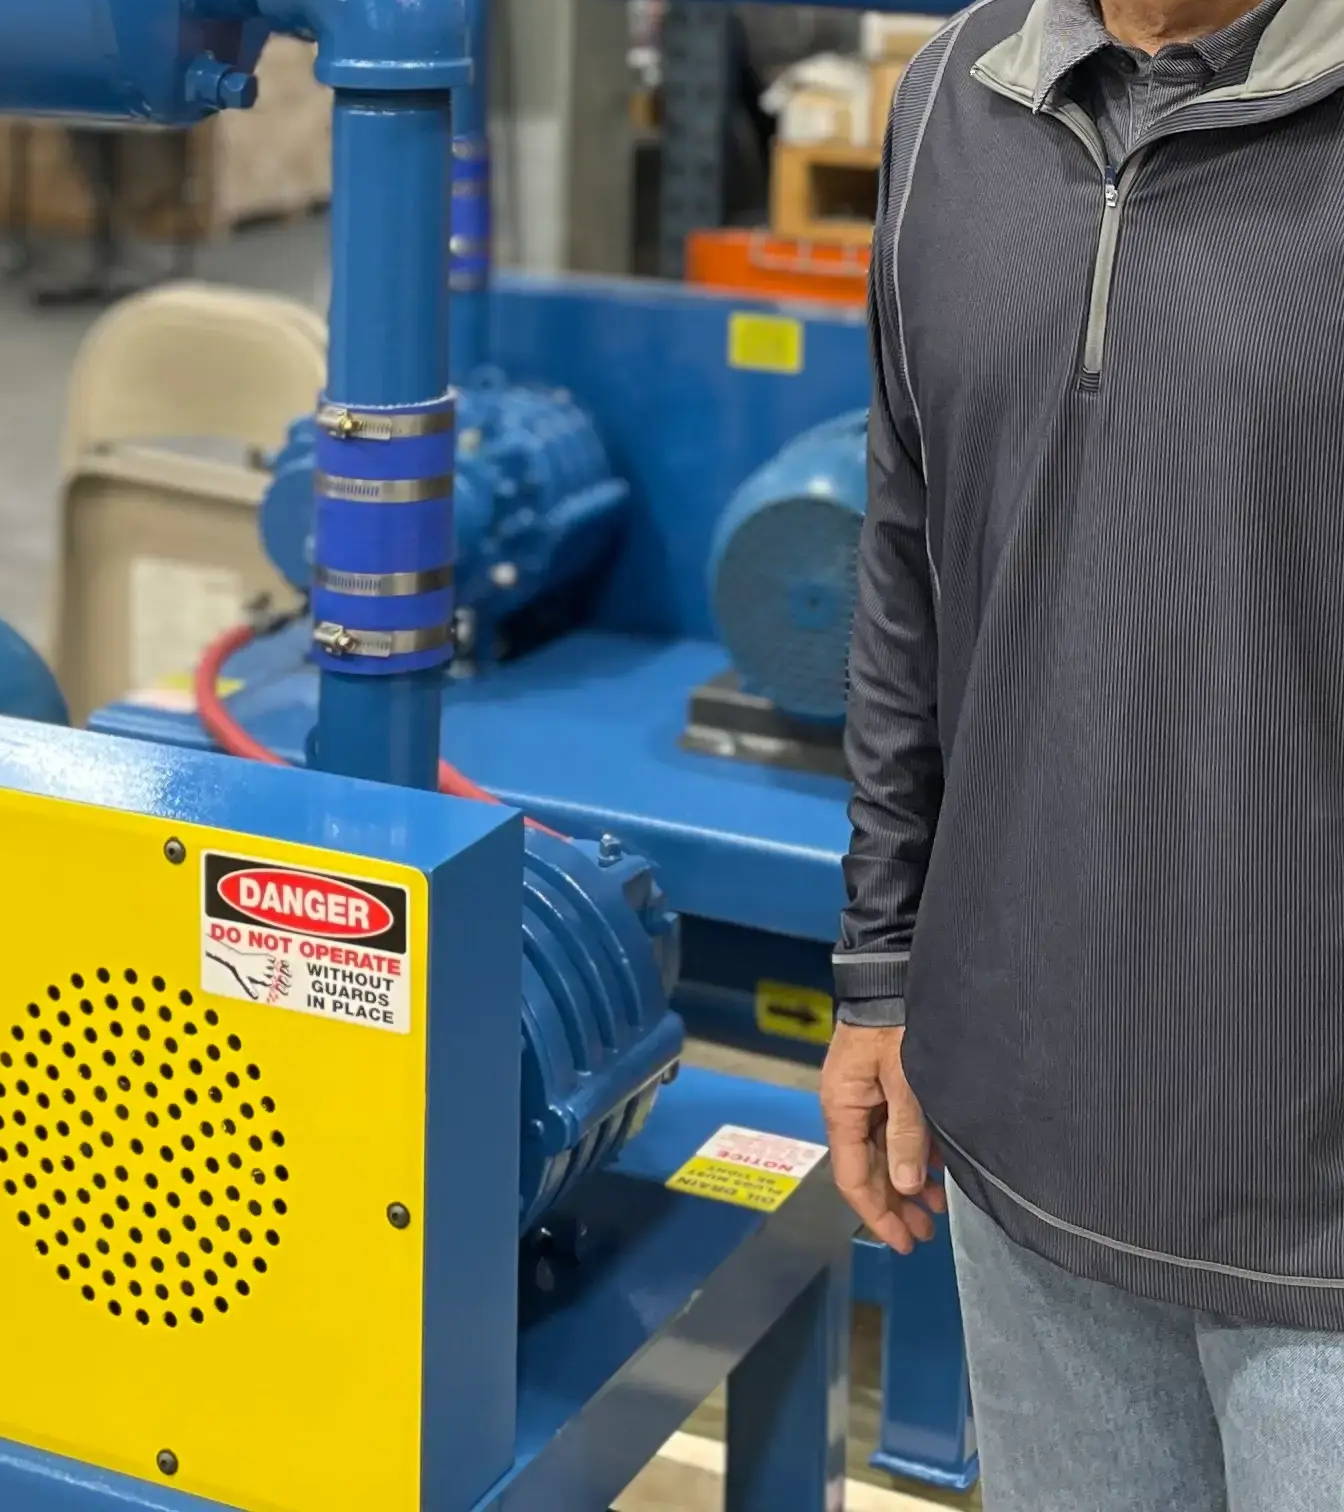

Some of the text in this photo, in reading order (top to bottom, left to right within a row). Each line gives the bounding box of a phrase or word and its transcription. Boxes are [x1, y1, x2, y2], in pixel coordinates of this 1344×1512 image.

[239, 877, 370, 930] DANGER
[210, 923, 401, 976] DO NOT OPERATE
[306, 962, 395, 992] WITHOUT
[311, 979, 390, 1007] GUARDS
[307, 994, 394, 1025] IN PLACE
[717, 1148, 794, 1173] NOTICE
[676, 1176, 738, 1196] DRAIN
